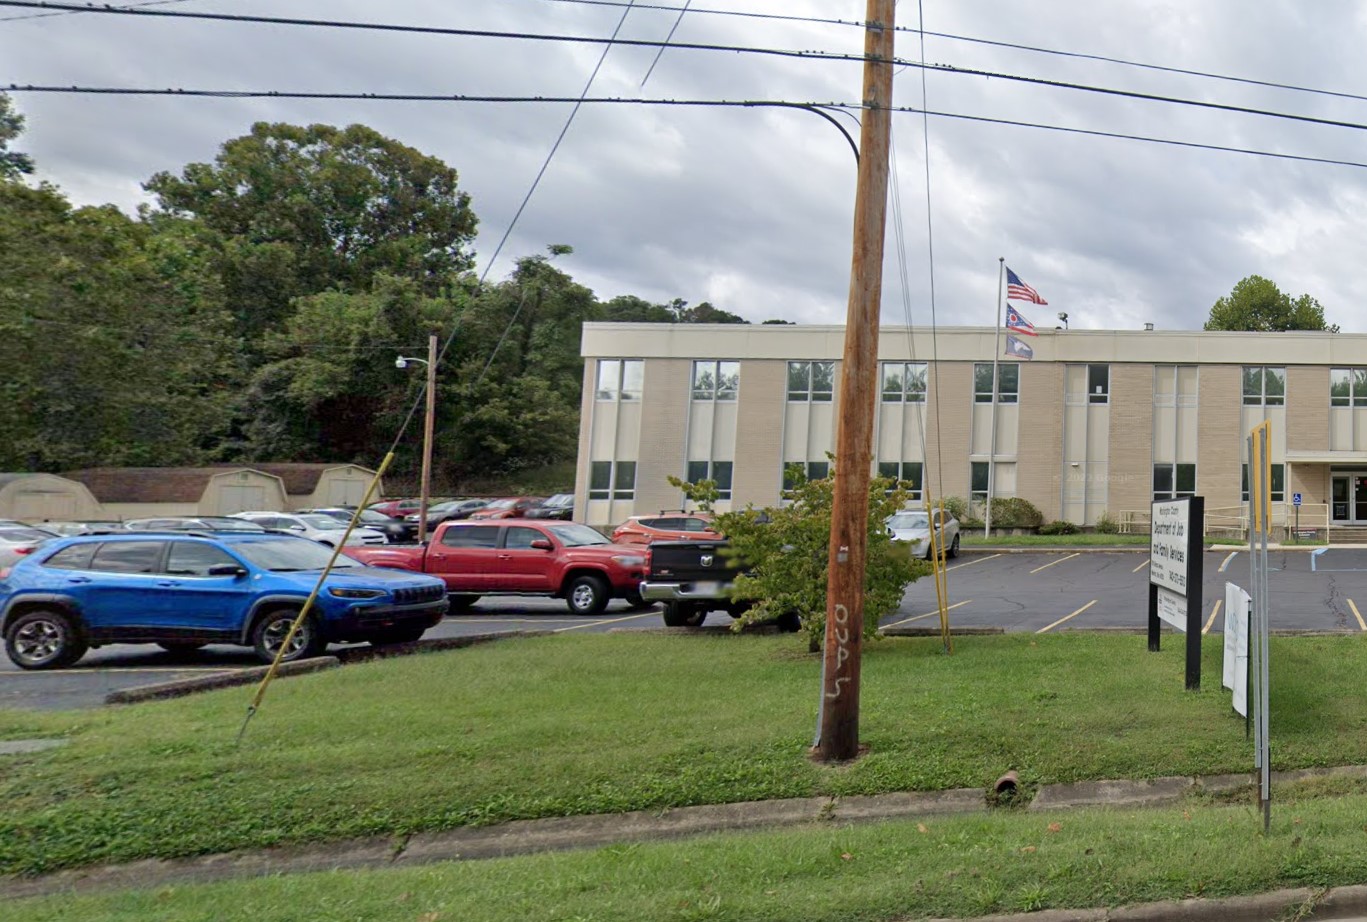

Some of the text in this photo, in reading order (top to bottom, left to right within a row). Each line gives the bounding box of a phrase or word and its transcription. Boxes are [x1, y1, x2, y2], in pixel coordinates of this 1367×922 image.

[1154, 521, 1172, 537] Department
[1159, 542, 1169, 561] Family
[1170, 545, 1184, 563] Services
